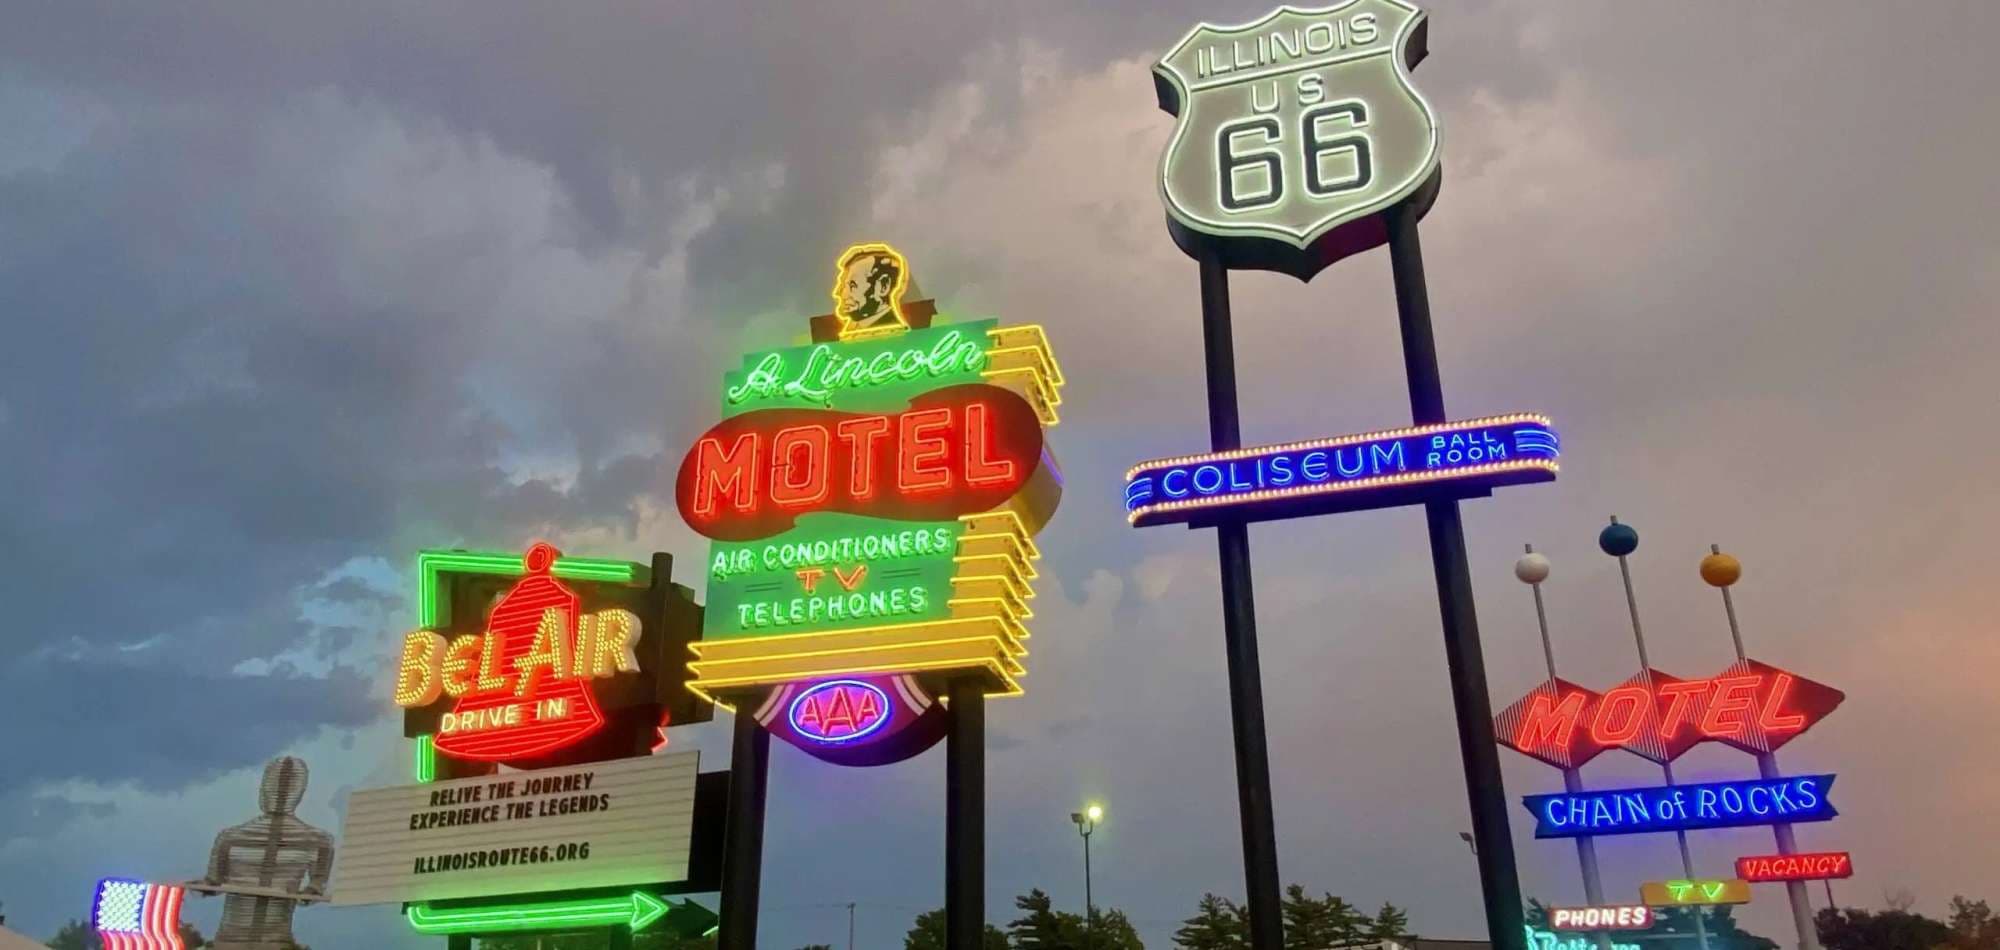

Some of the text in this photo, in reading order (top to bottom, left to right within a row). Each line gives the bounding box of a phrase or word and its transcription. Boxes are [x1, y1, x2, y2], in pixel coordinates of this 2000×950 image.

[1197, 13, 1378, 78] ILLINOIS
[1216, 98, 1373, 214] 66
[784, 330, 983, 397] Lincoln
[694, 404, 1014, 514] MOTEL
[1428, 442, 1506, 468] ROOM
[1432, 431, 1497, 449] BALL
[1163, 440, 1407, 496] COLISEUM
[712, 527, 950, 573] AIR CONDITIONERS
[738, 586, 928, 626] TELEPHONES
[513, 607, 635, 697] AIR
[440, 696, 566, 733] DRIVE IN
[799, 686, 879, 735] AAA
[1518, 673, 1805, 751] MOTEL
[410, 793, 609, 830] EXPERIENCE THE LEGENDS
[430, 772, 594, 807] RELIVE THE JOURNEY
[1547, 780, 1818, 828] CHAIN of ROCKS
[414, 841, 590, 875] ILLINOISROUTE66.ORG
[1744, 855, 1847, 877] VACANCY
[1554, 906, 1647, 927] PHONES
